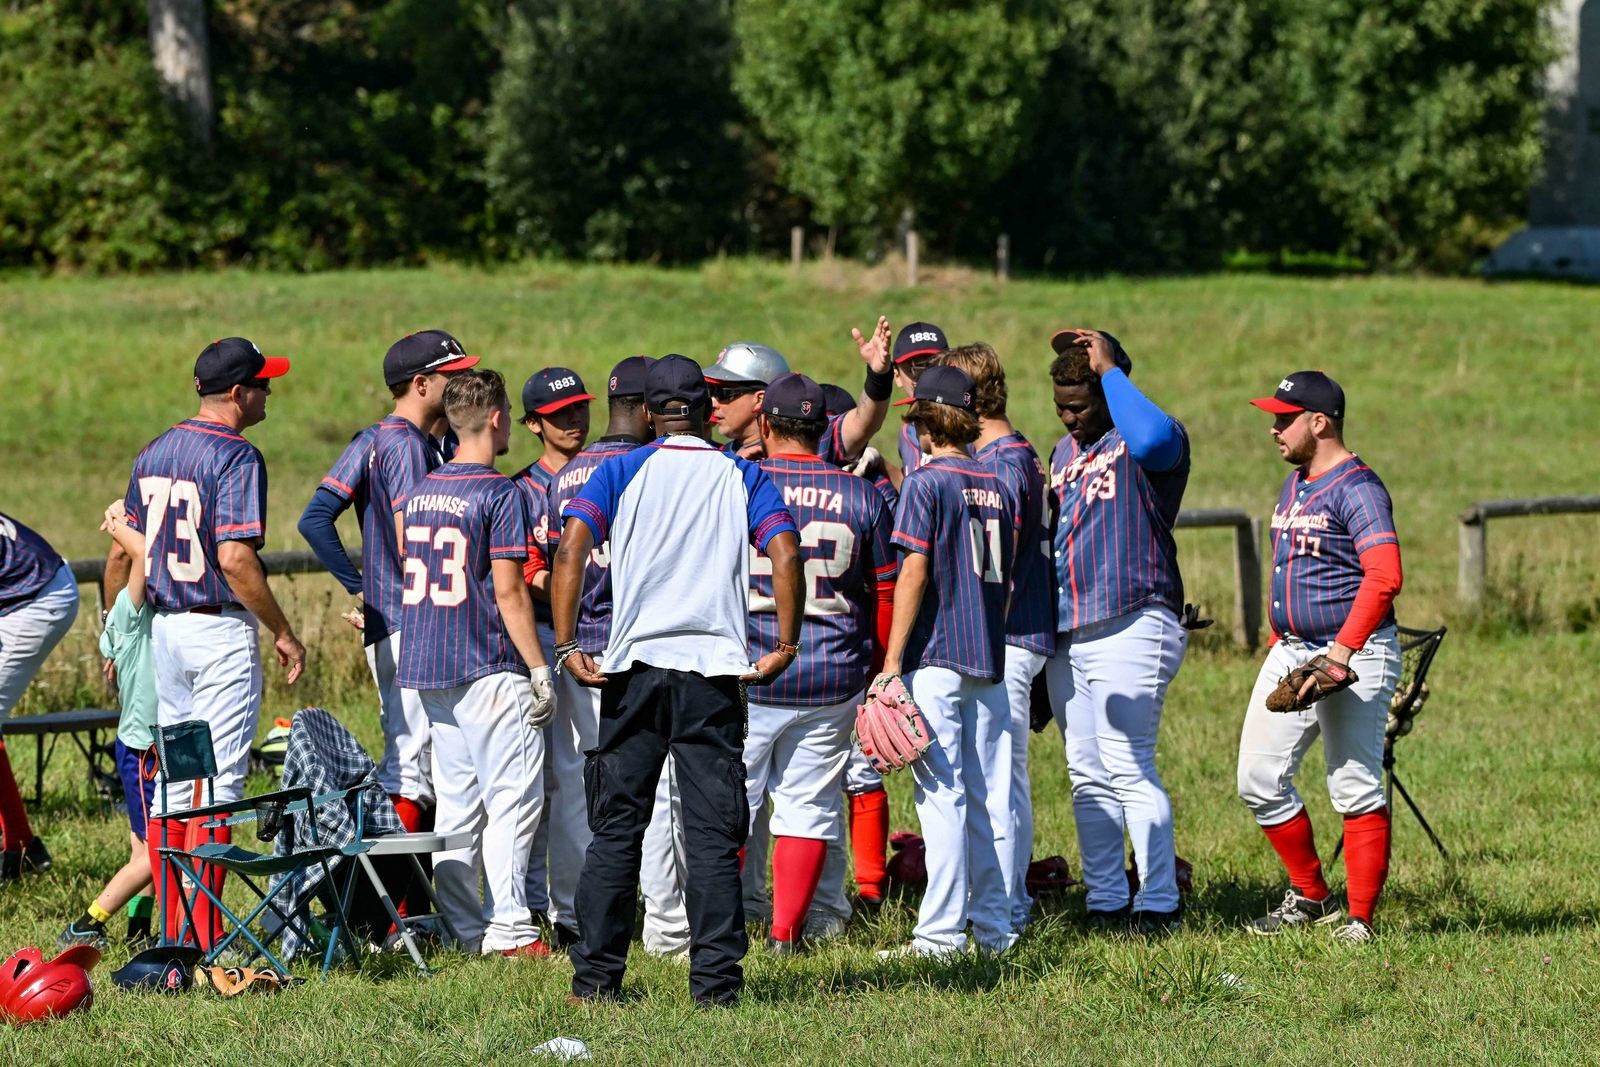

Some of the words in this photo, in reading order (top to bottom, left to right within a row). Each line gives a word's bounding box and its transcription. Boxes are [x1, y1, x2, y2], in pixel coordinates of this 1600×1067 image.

[909, 331, 938, 344] 1883
[548, 375, 576, 392] 1883
[557, 466, 598, 494] AKOU
[406, 494, 470, 519] ATHANASE
[784, 486, 844, 515] MOTA
[138, 475, 206, 583] 73
[402, 525, 467, 607] 53
